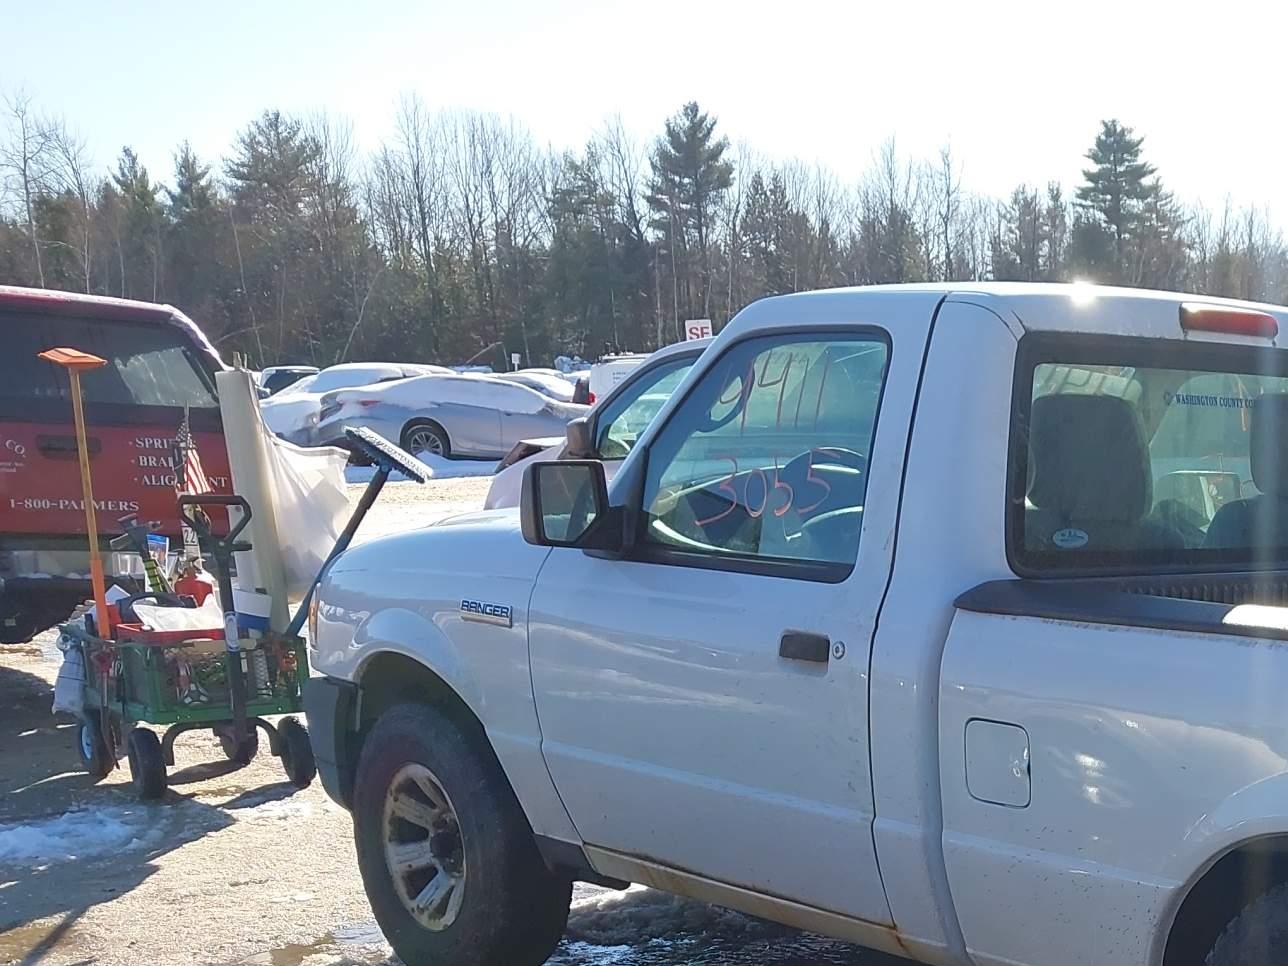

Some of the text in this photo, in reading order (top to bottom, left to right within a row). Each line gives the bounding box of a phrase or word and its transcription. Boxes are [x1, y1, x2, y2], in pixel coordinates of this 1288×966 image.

[1175, 393, 1218, 406] WASHINGTON
[1219, 397, 1244, 409] COUNTY
[135, 437, 168, 449] SPRI
[142, 475, 228, 487] ALIGNT
[461, 599, 510, 619] RANGER
